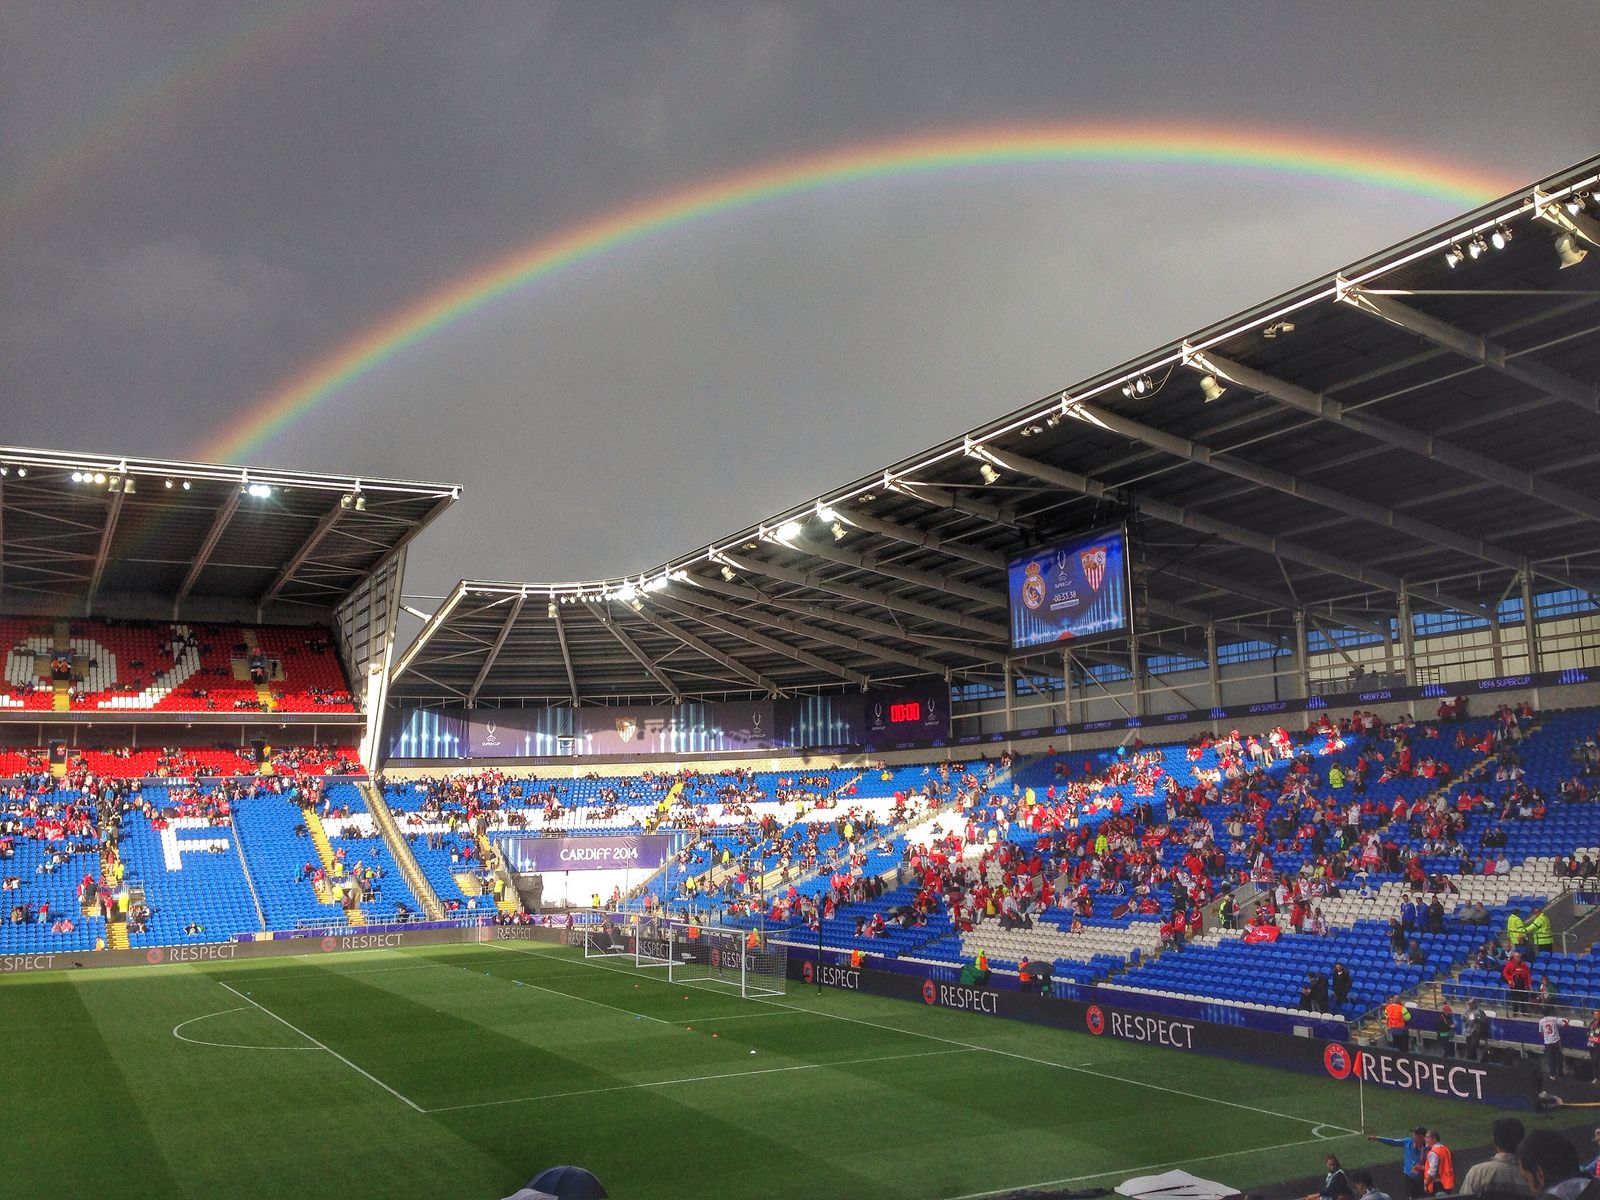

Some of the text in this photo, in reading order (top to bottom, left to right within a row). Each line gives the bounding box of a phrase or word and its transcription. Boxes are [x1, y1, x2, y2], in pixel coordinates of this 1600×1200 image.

[1479, 676, 1531, 688] UEFA SUPER CUP
[1360, 692, 1380, 700] CARDIFF
[890, 702, 920, 722] 00:00
[1249, 705, 1260, 713] UEFA
[1261, 703, 1276, 711] SUPER
[560, 847, 638, 861] CARDIFF 2014
[497, 927, 532, 939] RESPECT
[342, 933, 403, 950] RESPECT
[169, 944, 238, 961] RESPECT
[721, 950, 756, 971] RESPCT
[0, 955, 55, 971] SPECT
[940, 985, 999, 1014] RESPECT
[1111, 1012, 1195, 1049] RESPECT
[1546, 1023, 1553, 1035] 3
[1362, 1051, 1488, 1100] RESPECT
